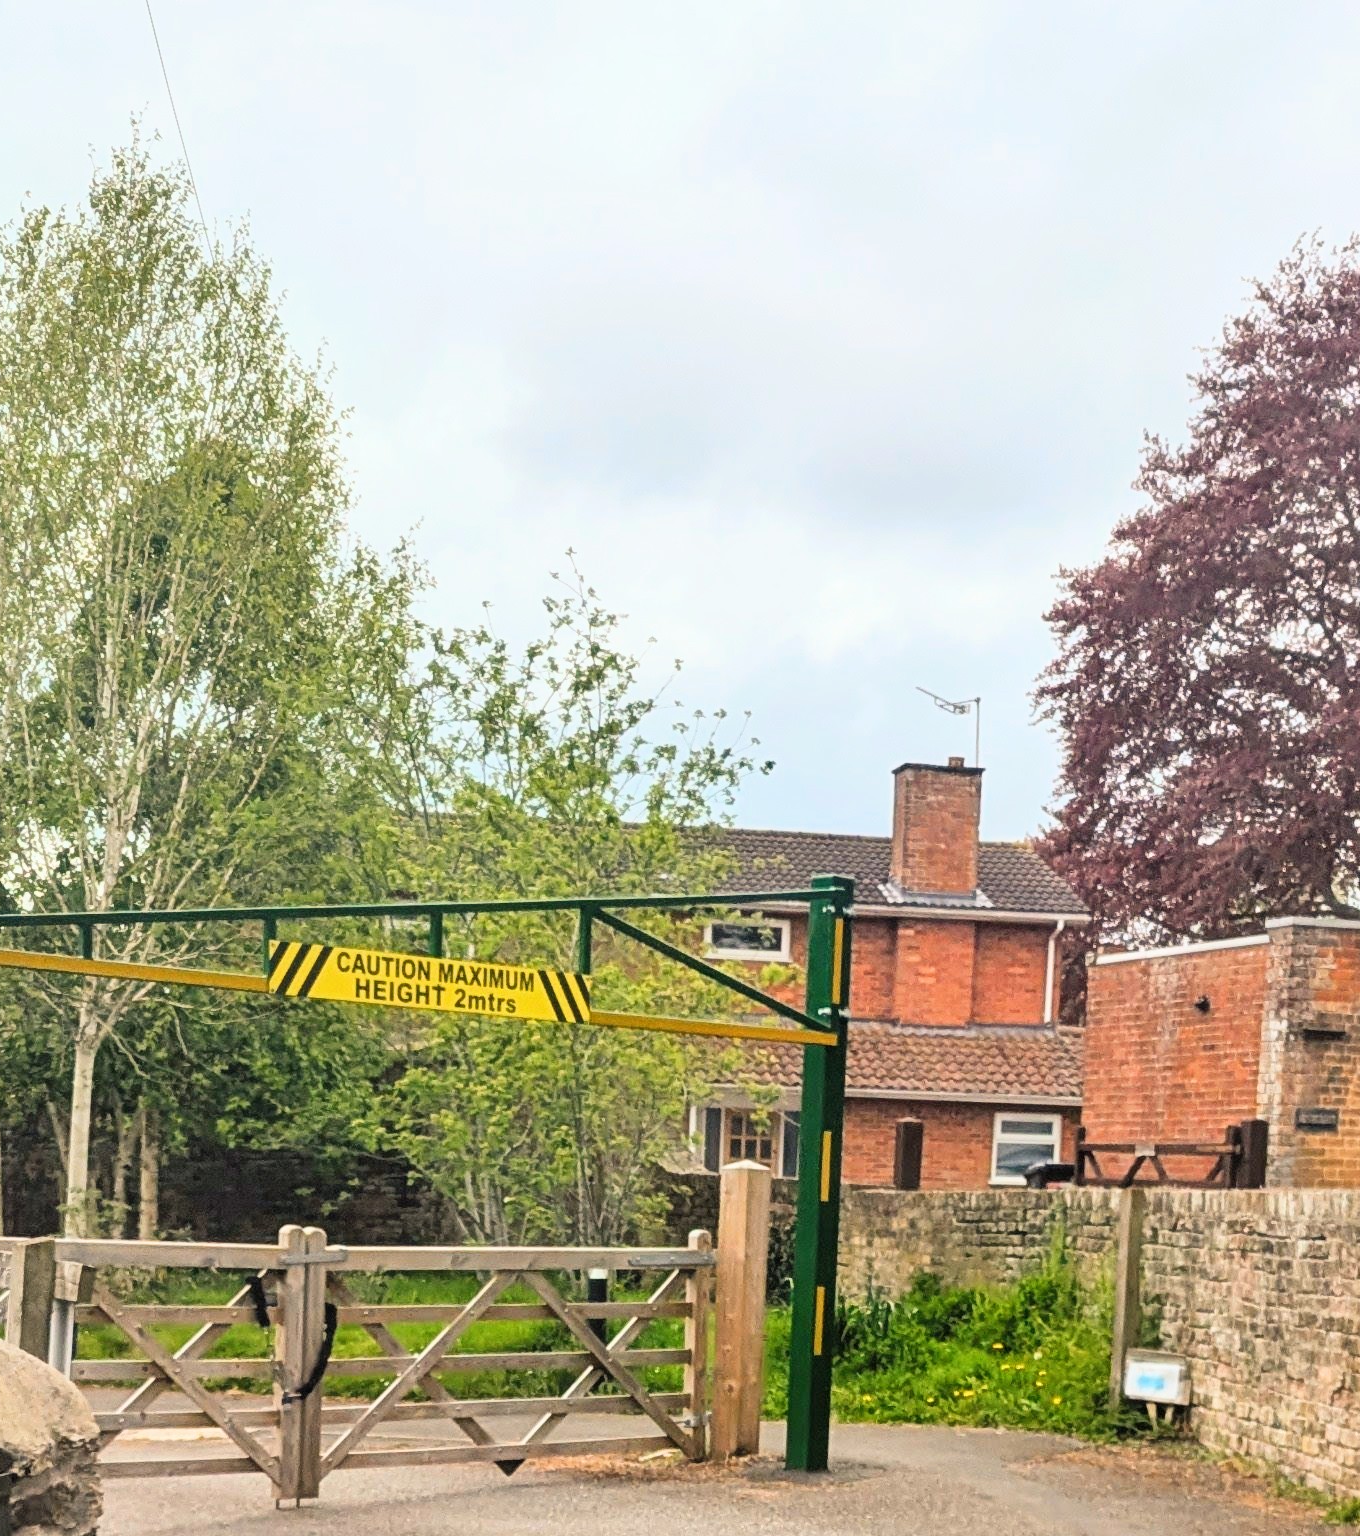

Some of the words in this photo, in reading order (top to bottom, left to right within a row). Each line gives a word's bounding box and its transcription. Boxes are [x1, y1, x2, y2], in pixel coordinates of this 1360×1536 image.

[337, 951, 431, 982] CAUTION
[439, 963, 535, 993] MAXIMUM
[355, 977, 446, 1007] HEIGHT
[454, 988, 517, 1014] 2mtrs
